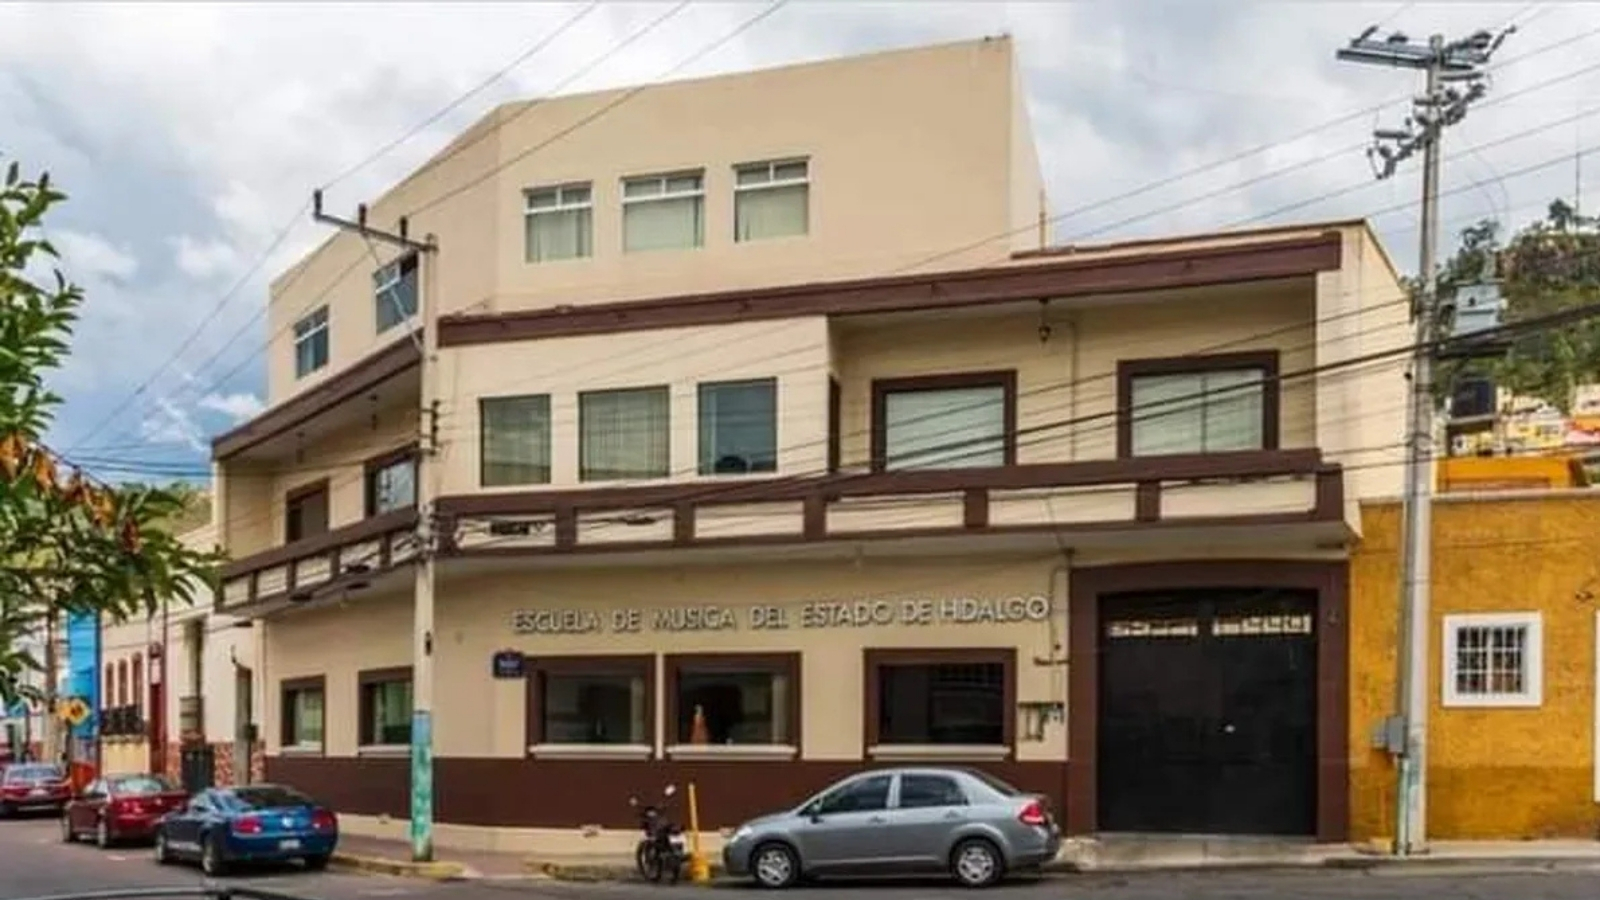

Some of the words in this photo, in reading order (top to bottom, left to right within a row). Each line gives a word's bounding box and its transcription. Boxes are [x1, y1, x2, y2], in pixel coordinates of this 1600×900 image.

[513, 608, 600, 634] ESCUELA
[612, 609, 642, 633] DE
[654, 606, 736, 631] MUSICA
[750, 605, 790, 630] DEL
[802, 601, 893, 628] ESTADO
[901, 600, 932, 626] DE
[940, 595, 1050, 624] HIDALGO
